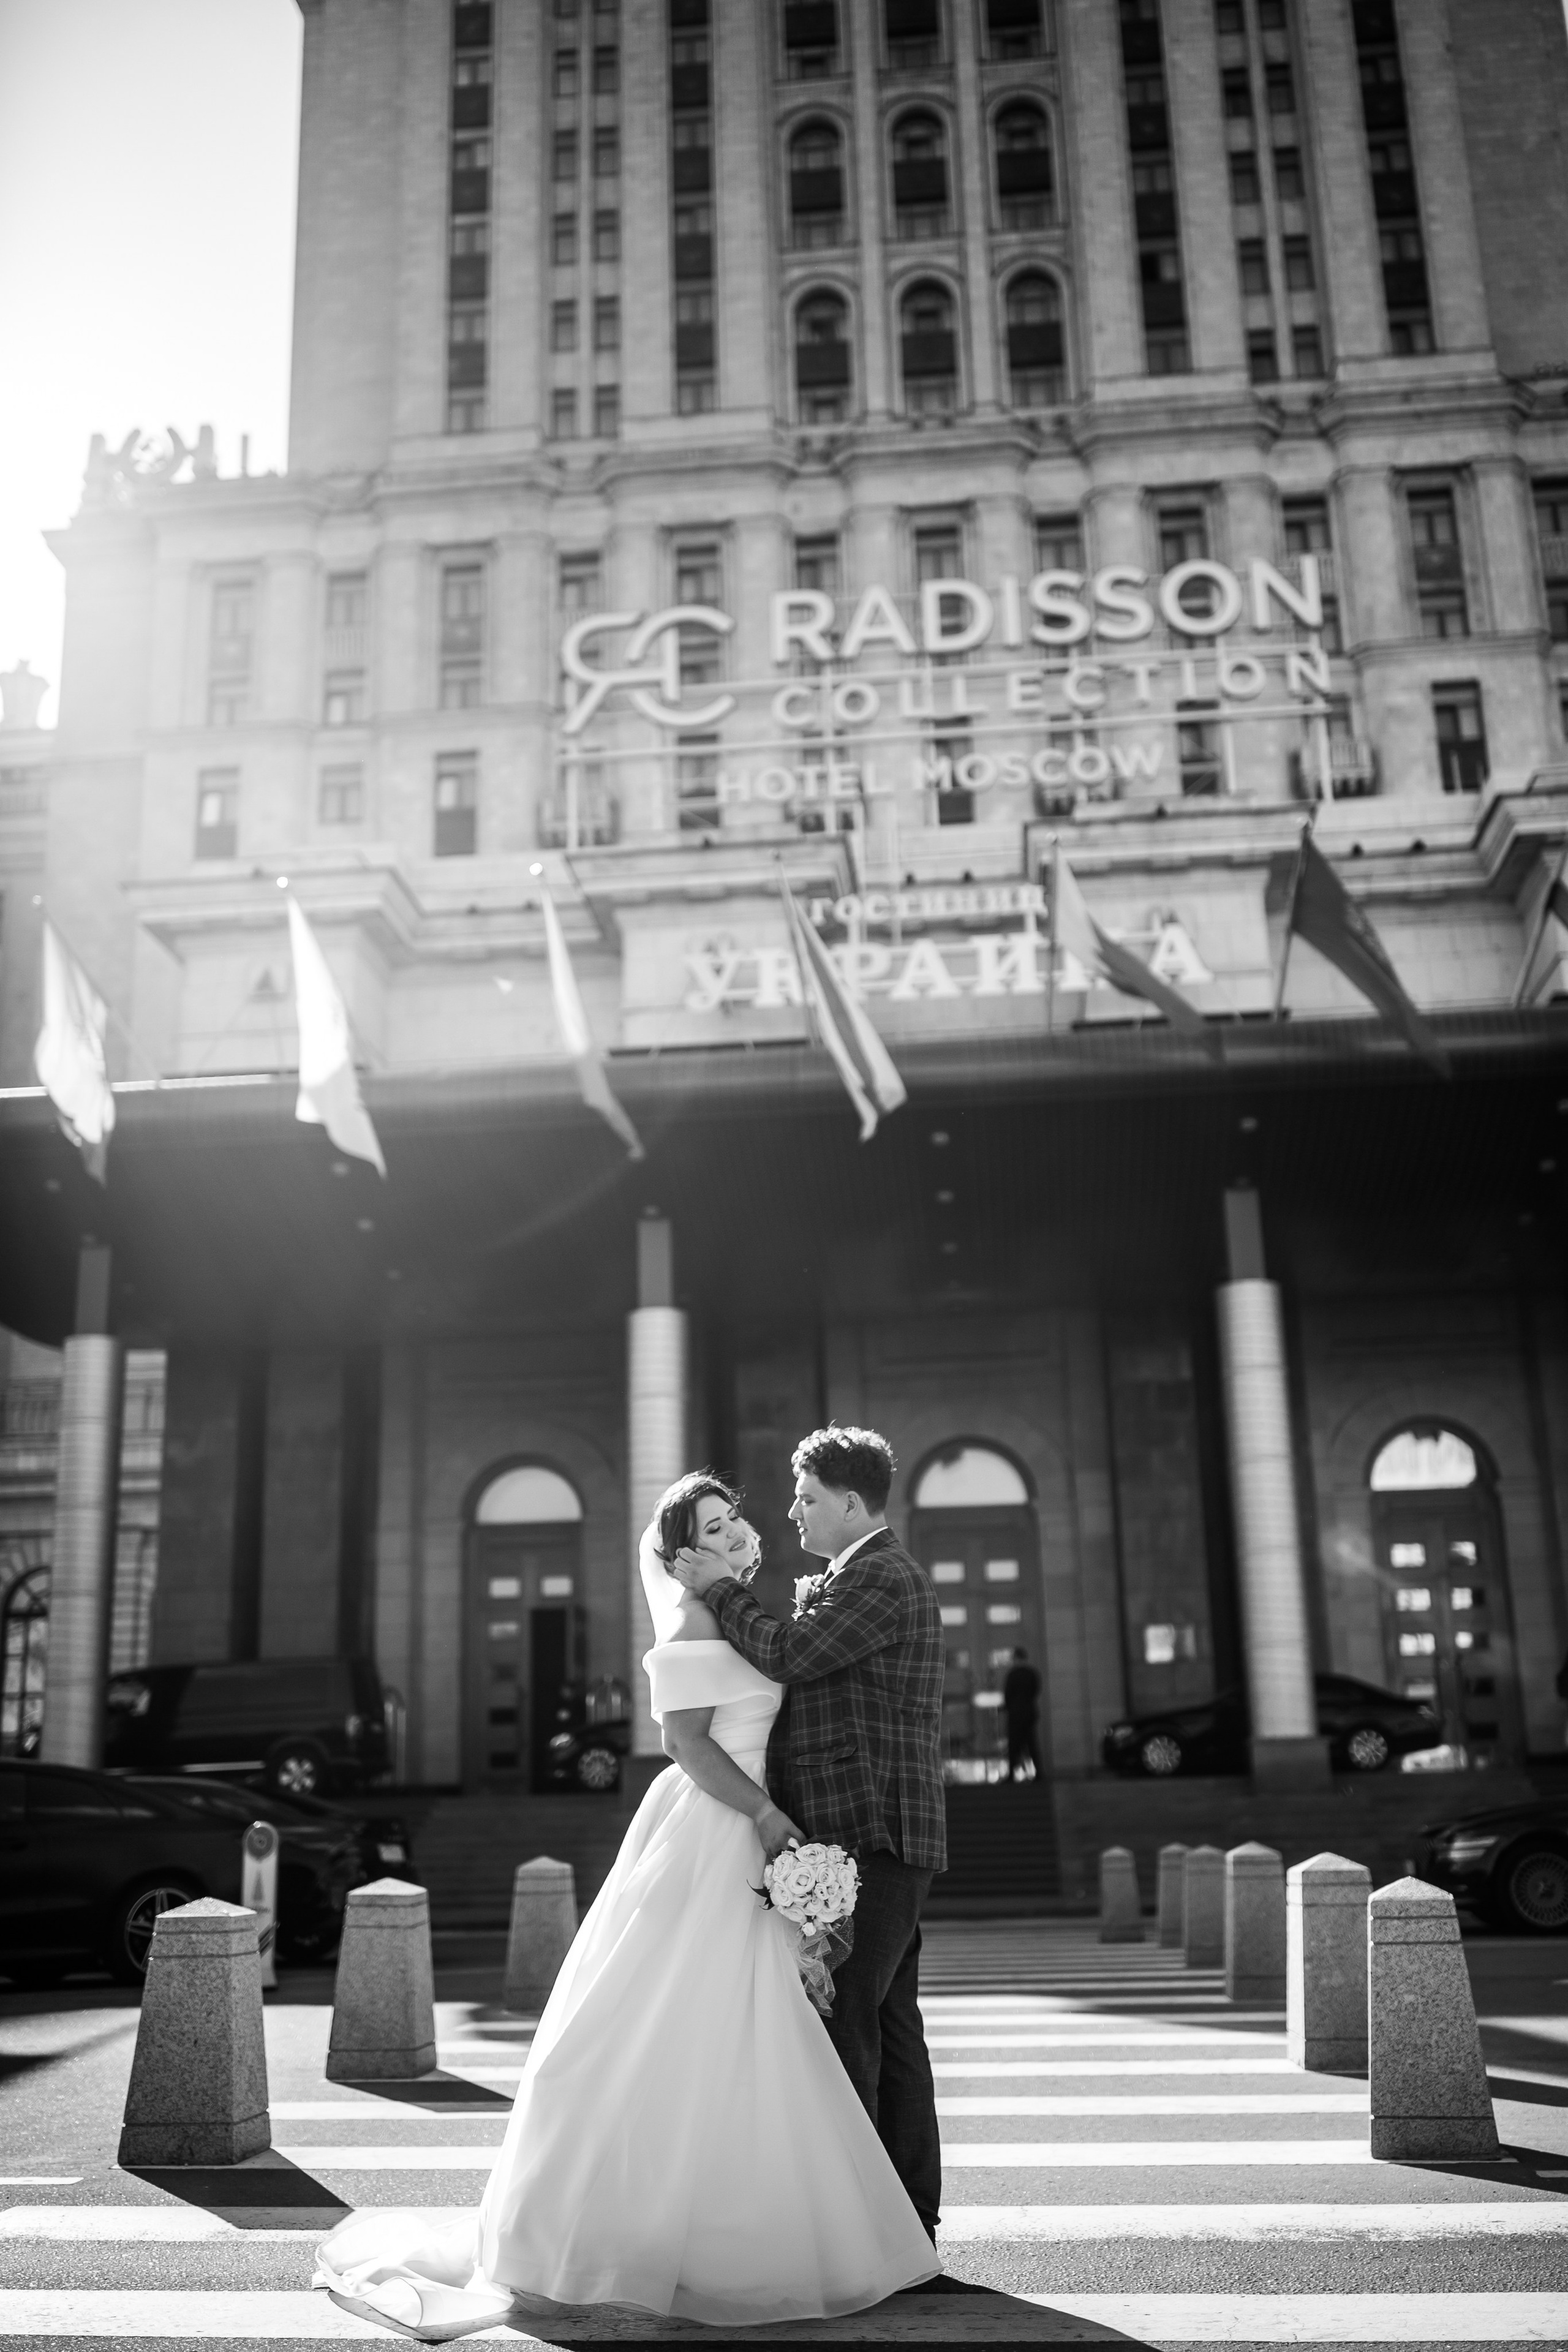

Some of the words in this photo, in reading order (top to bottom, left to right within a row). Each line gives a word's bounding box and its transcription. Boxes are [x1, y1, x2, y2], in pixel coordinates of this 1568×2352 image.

[769, 552, 1324, 665] RADISSON
[772, 652, 1332, 729] COLLECTION
[715, 760, 892, 804] HOTEL
[915, 741, 1163, 794] MOSCOW
